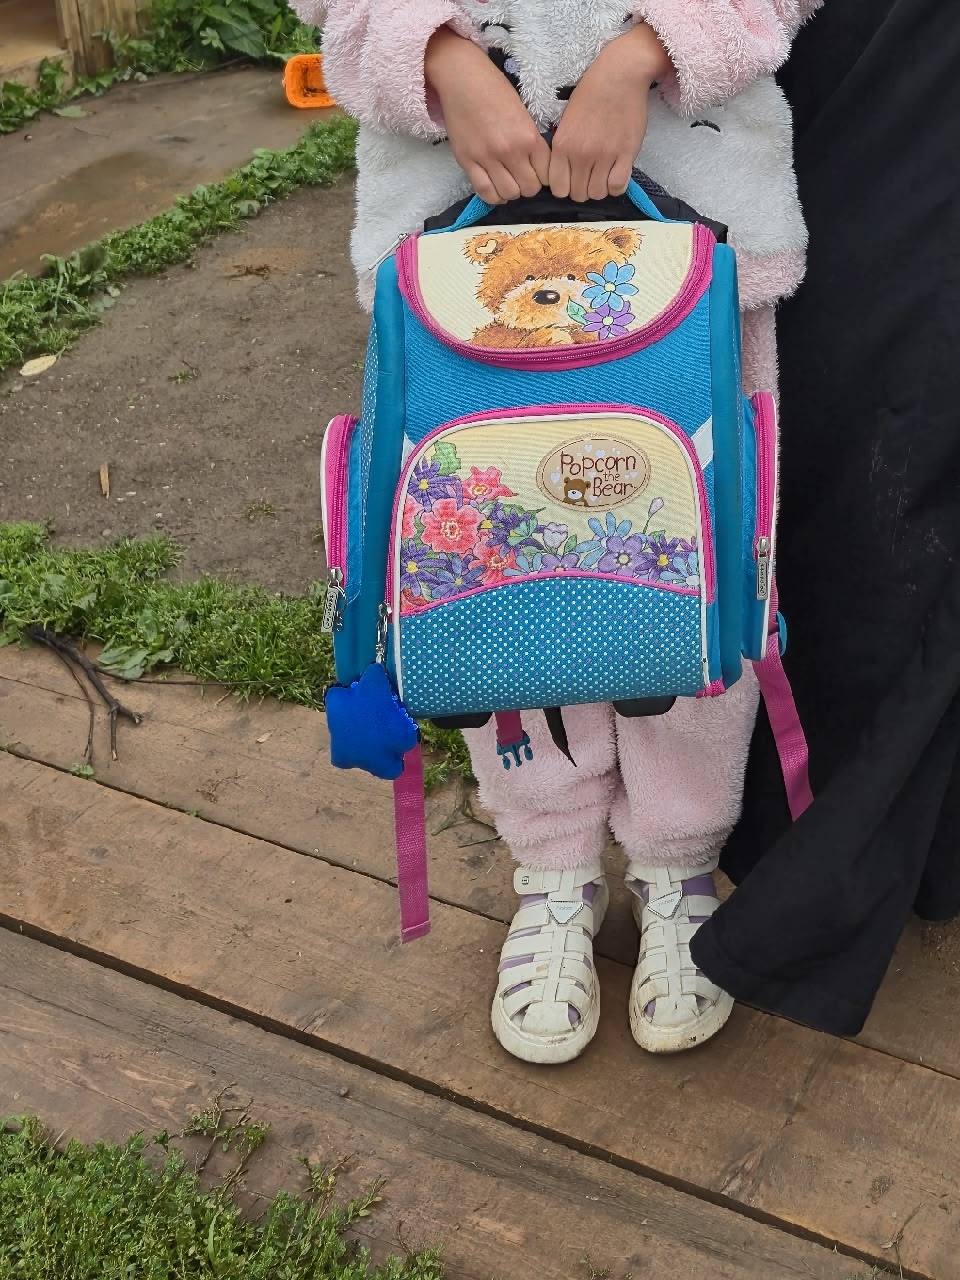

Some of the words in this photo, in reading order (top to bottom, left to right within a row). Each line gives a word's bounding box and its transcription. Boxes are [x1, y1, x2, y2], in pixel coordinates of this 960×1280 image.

[560, 450, 637, 478] Popcorn
[593, 476, 635, 498] Bear
[602, 470, 621, 482] the
